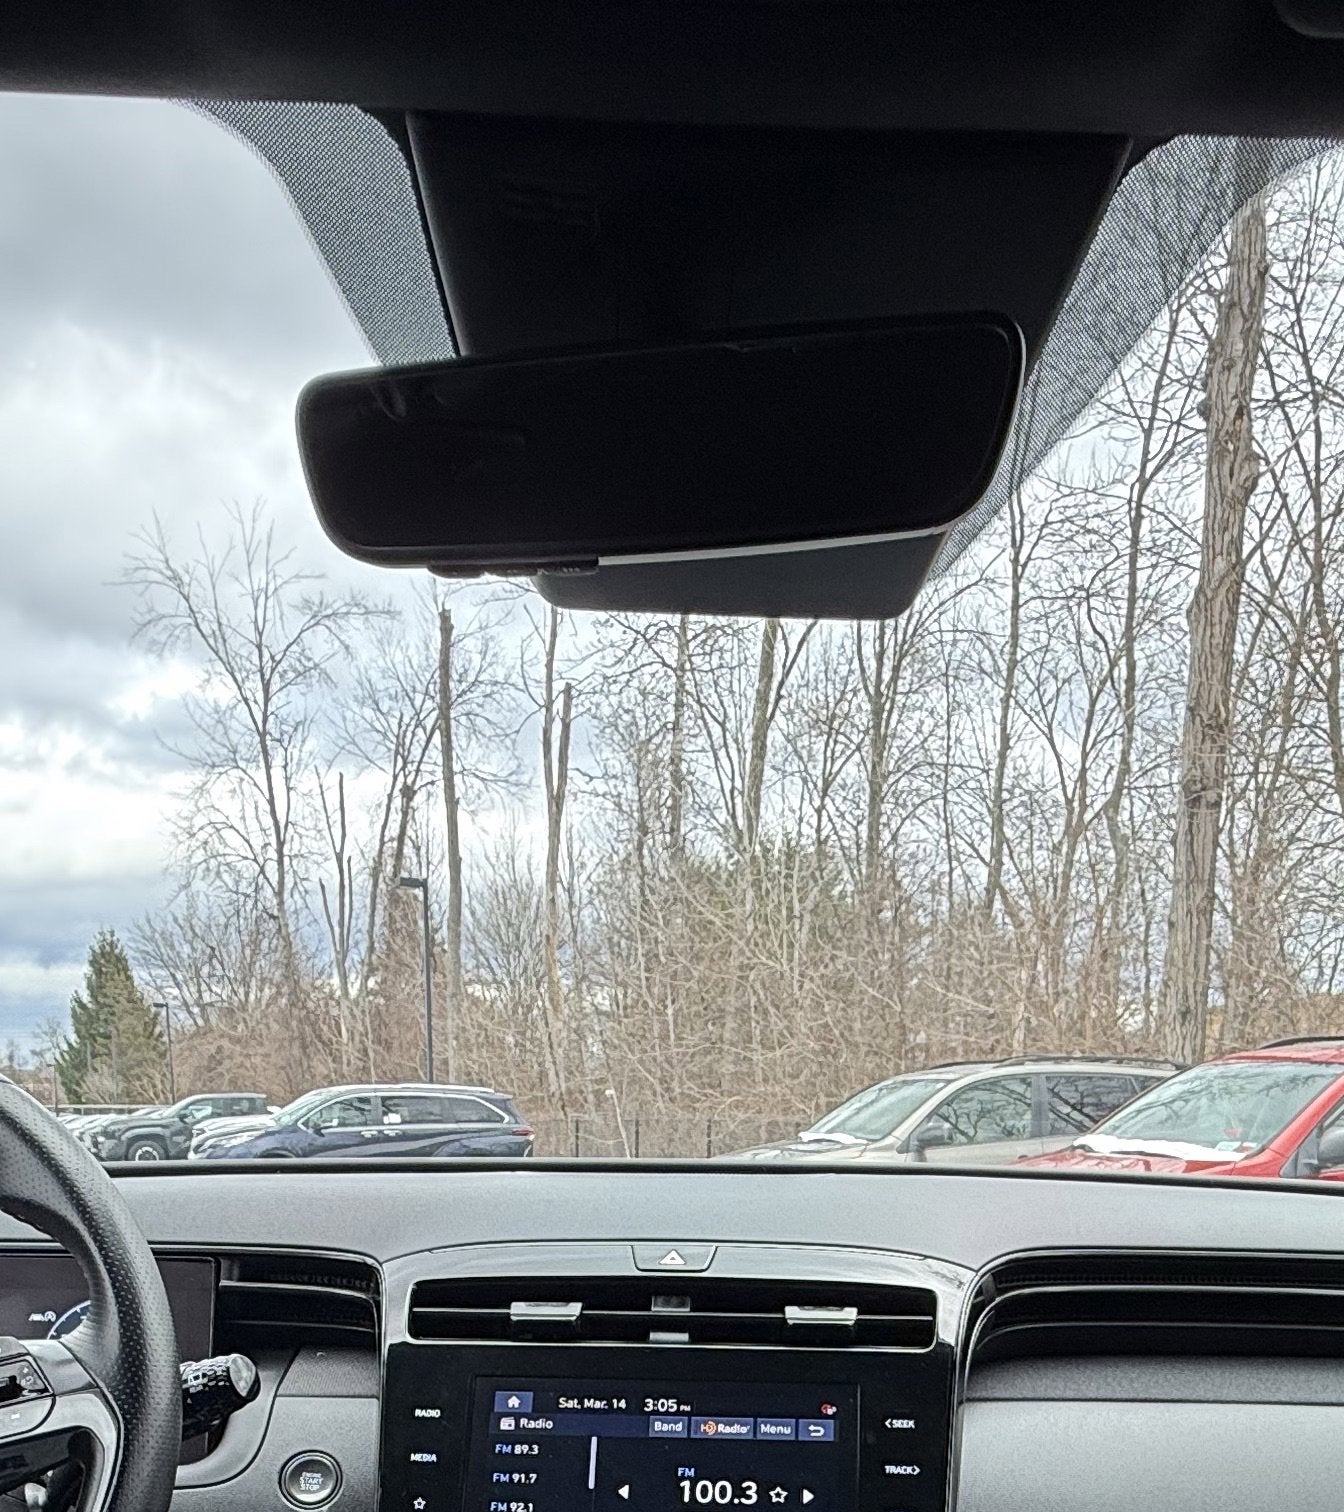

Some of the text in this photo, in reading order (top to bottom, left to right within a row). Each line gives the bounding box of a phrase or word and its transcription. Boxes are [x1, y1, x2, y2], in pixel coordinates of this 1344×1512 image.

[612, 1399, 627, 1410] 14
[643, 1398, 678, 1413] 3:05
[414, 1409, 441, 1418] RADIO
[519, 1418, 554, 1430] Radio
[654, 1421, 683, 1432] Band
[760, 1423, 792, 1434] Menu
[892, 1419, 916, 1429] SEEK
[495, 1444, 539, 1455] FM 89.3
[410, 1453, 437, 1462] MEDIA
[677, 1467, 695, 1477] FM
[492, 1472, 537, 1484] FM 91.7
[679, 1479, 758, 1505] 100.3
[490, 1501, 534, 1512] FM 92.1
